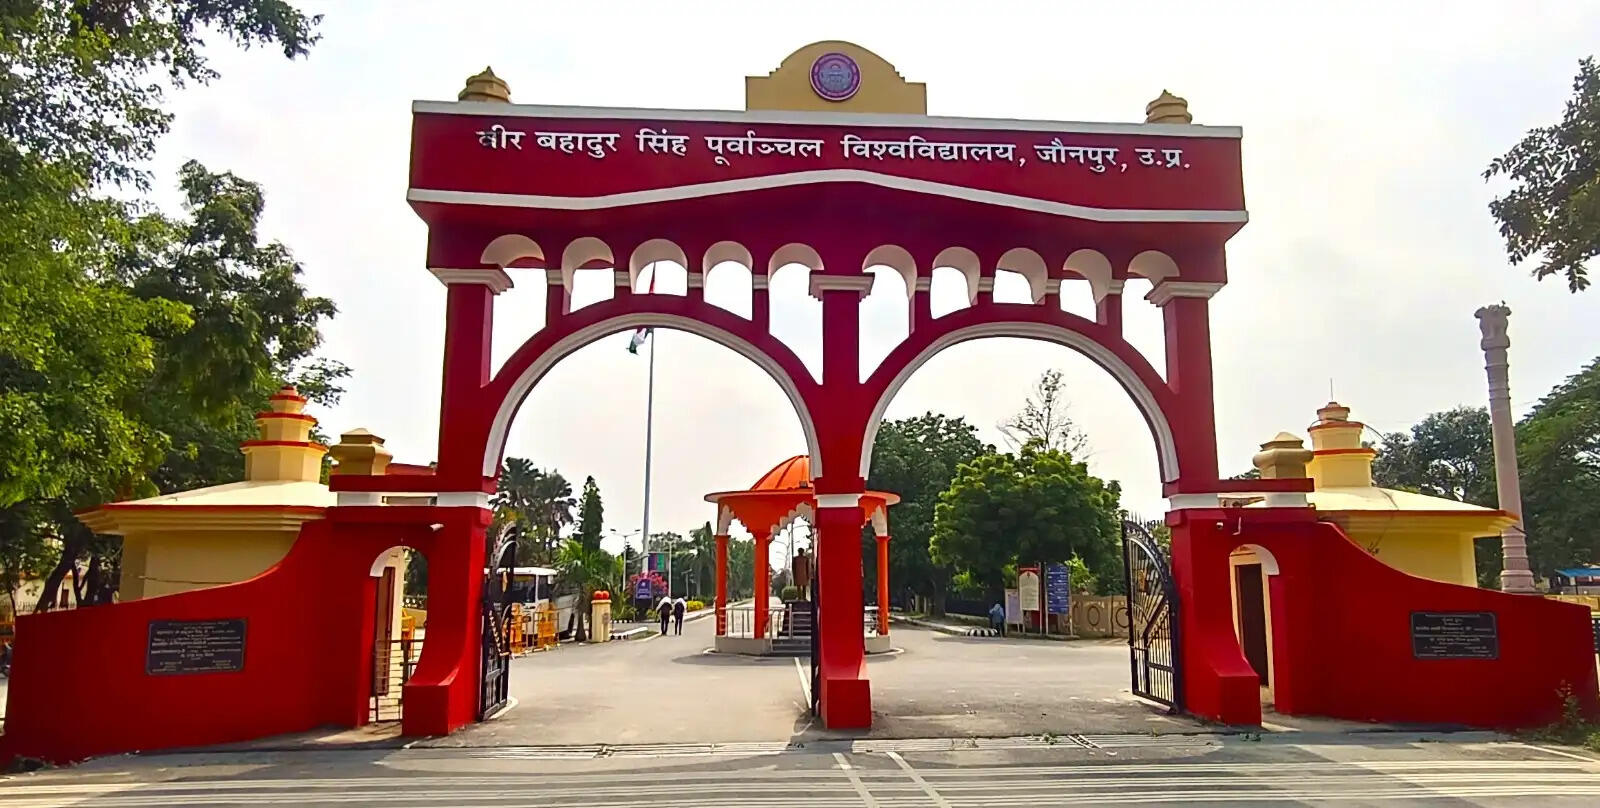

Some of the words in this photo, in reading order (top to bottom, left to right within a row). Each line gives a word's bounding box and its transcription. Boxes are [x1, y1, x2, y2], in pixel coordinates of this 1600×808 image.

[476, 125, 525, 149] वीर
[534, 131, 621, 158] बहादुर
[635, 128, 690, 157] सिंह
[840, 135, 1026, 167] विश्वविद्यालय,
[1033, 137, 1128, 173] जौनपुर,
